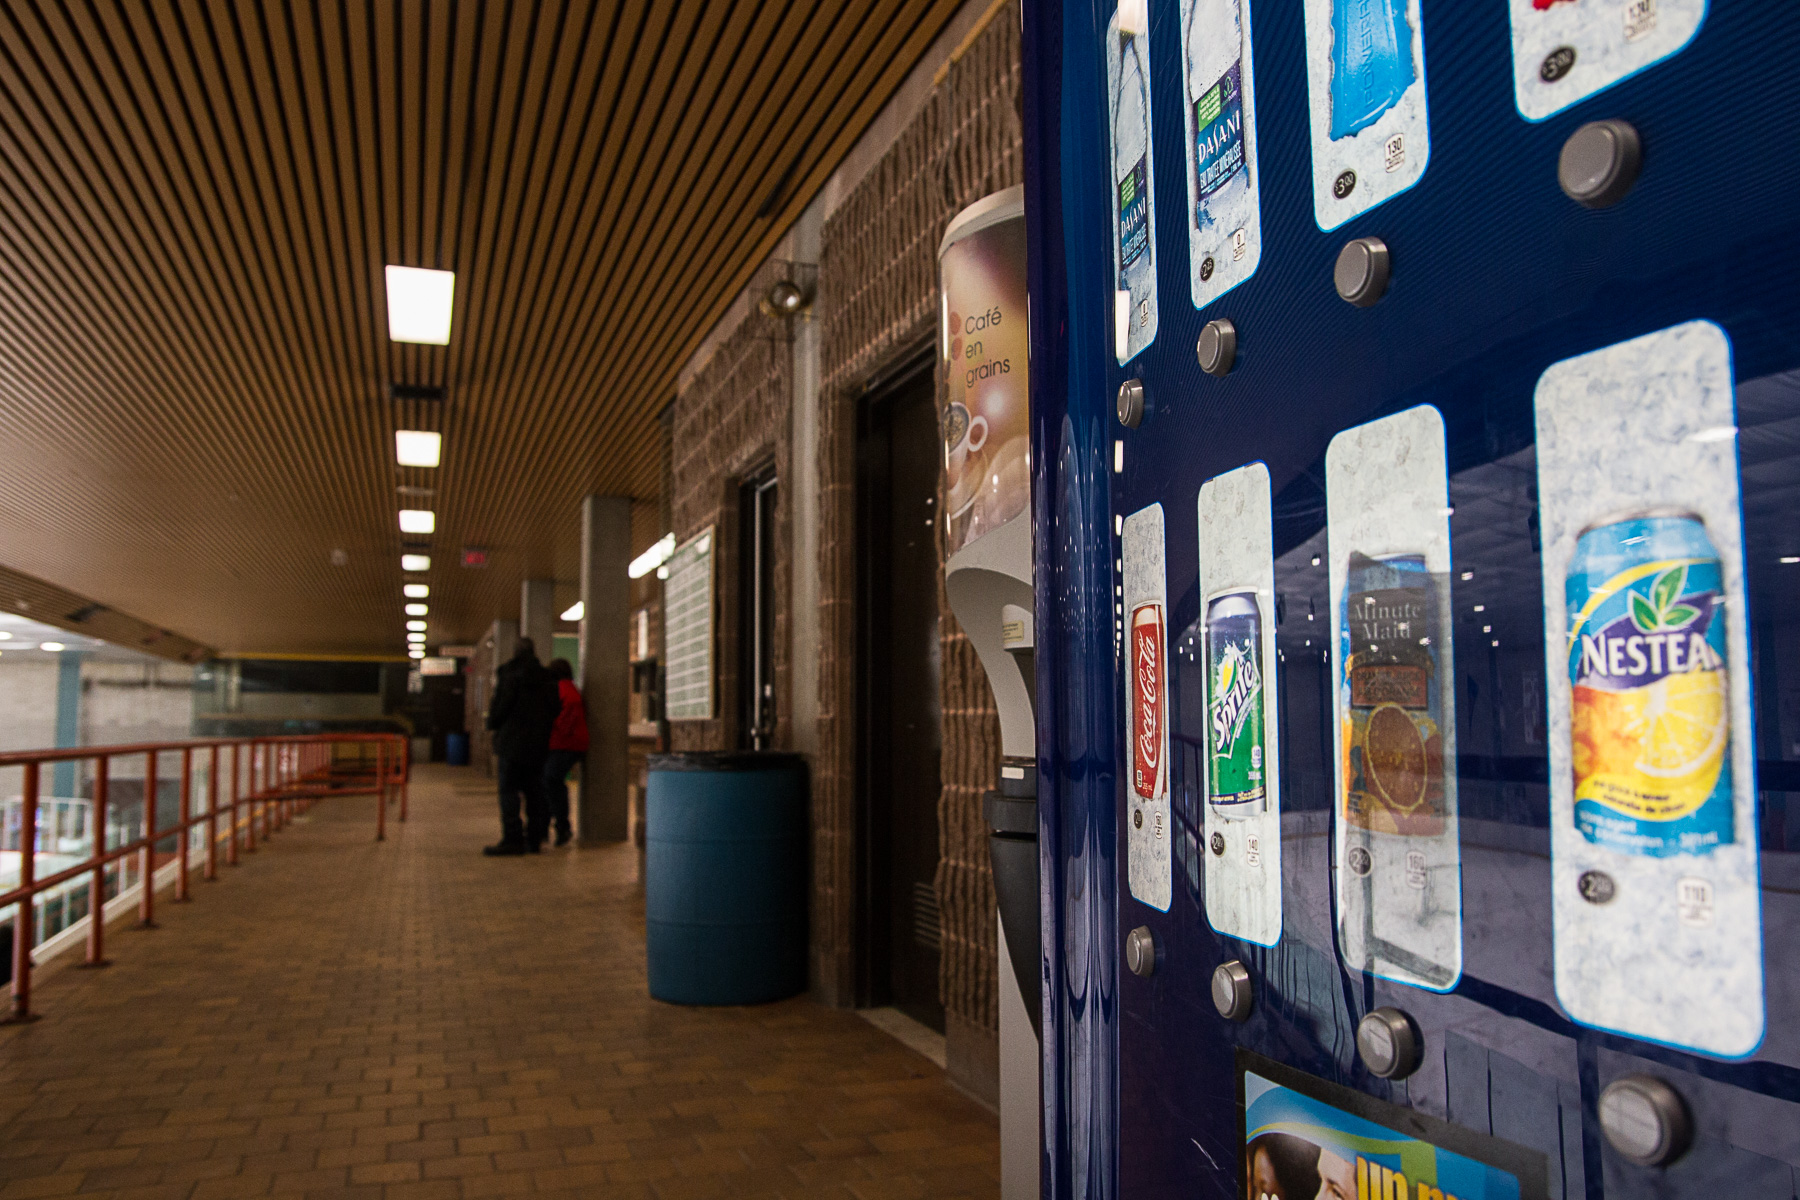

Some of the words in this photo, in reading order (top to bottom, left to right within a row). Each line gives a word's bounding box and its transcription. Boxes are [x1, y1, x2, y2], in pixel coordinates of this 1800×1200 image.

[1359, 0, 1375, 108] POWERA
[1199, 110, 1240, 165] DASANI
[1121, 197, 1146, 239] DASANI
[965, 306, 1002, 335] Café
[965, 341, 983, 359] en
[966, 358, 1011, 388] grains
[1354, 602, 1420, 621] Minute
[1362, 620, 1410, 640] Maid
[1581, 633, 1717, 677] NESTEA
[1213, 656, 1254, 753] Sprite
